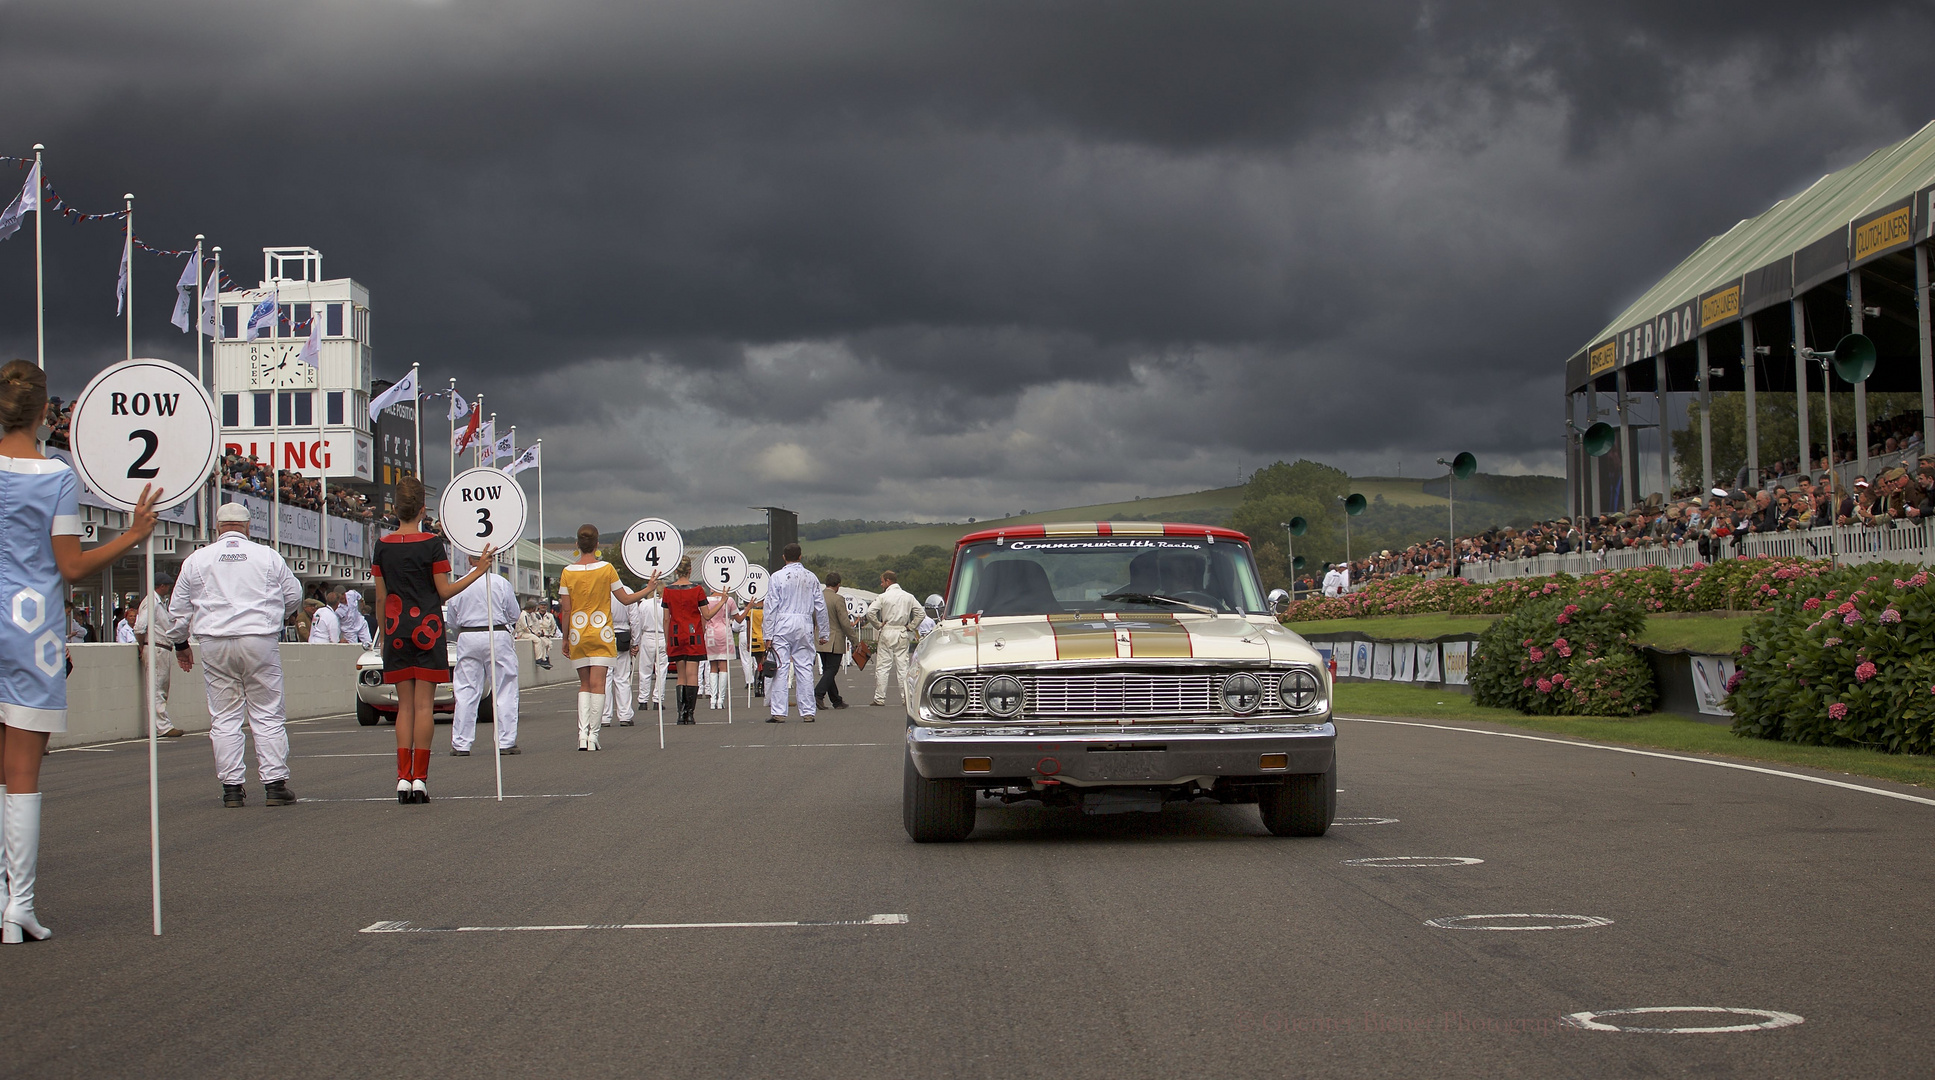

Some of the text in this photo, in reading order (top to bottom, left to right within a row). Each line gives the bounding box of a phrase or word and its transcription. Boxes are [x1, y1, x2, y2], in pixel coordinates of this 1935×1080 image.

[1857, 214, 1908, 253] CLUTCH LINERS
[1623, 305, 1692, 366] FERODO
[250, 346, 258, 385] ROLEX
[111, 392, 180, 417] ROW
[126, 429, 160, 479] 2
[461, 485, 502, 502] ROW
[475, 507, 494, 538] 3
[85, 525, 94, 538] 9
[638, 531, 666, 542] ROW
[164, 538, 173, 551] 11
[1010, 540, 1202, 550] Commonwealth Racing
[645, 546, 660, 567] 4
[713, 556, 736, 564] ROW
[294, 560, 305, 571] 16
[317, 564, 329, 574] 17
[340, 568, 351, 578] 18
[361, 571, 372, 581] 19
[720, 567, 731, 584] 5
[747, 572, 762, 580] OW
[747, 581, 757, 595] 6
[847, 602, 854, 611] 0
[1083, 621, 1151, 629] 12
